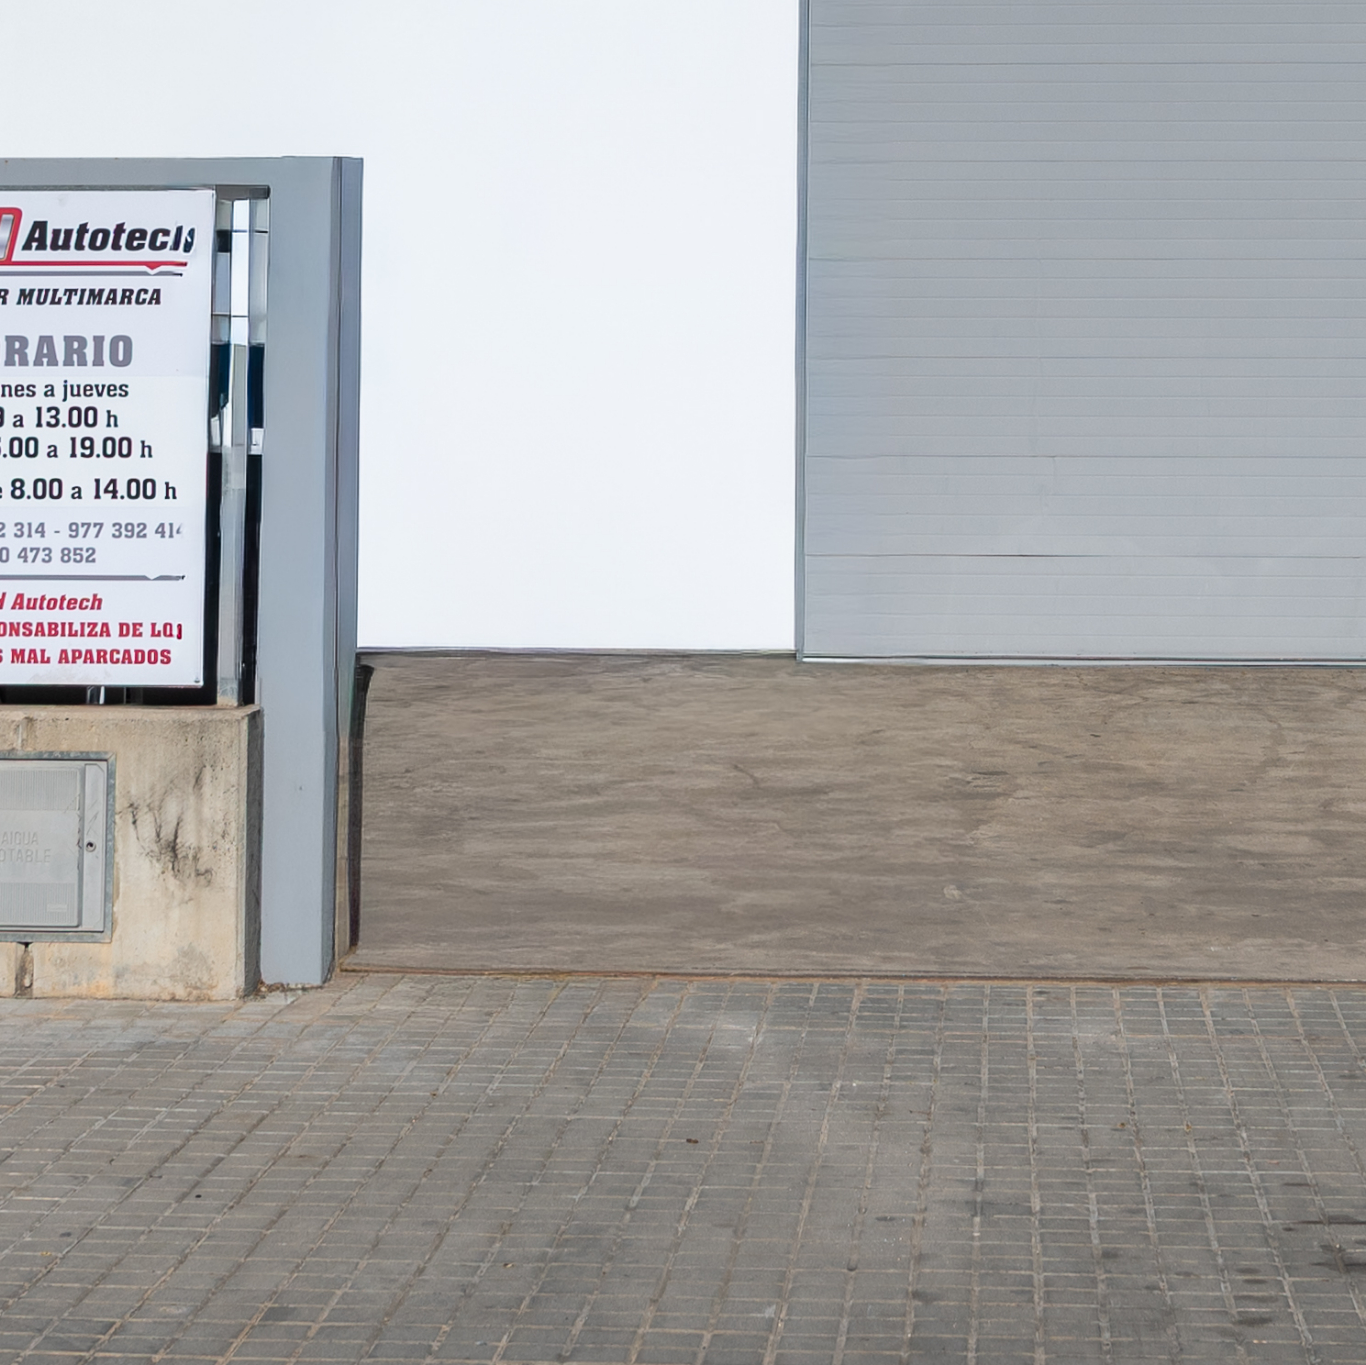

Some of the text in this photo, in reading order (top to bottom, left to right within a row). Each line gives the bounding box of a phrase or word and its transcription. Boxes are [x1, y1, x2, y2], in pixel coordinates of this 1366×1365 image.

[16, 288, 162, 305] MULTIMARCA
[43, 384, 56, 398] a
[61, 380, 129, 402] jueves
[12, 414, 24, 428] a
[36, 406, 98, 428] 13.00
[106, 409, 119, 428] h
[46, 445, 59, 459] a
[69, 437, 133, 459] 19.00
[140, 440, 153, 458] h
[10, 478, 63, 500] 8.00
[70, 486, 83, 500] a
[93, 478, 157, 500] 14.00
[164, 481, 178, 500] h
[13, 522, 46, 538] 314
[68, 522, 103, 538] 977
[111, 522, 147, 539] 392
[17, 546, 53, 564] 473
[60, 546, 96, 564] 852
[10, 593, 103, 611] Autotech
[118, 622, 143, 638] DE
[10, 648, 51, 665] MAL
[57, 648, 172, 665] APARCADOS
[1, 830, 39, 845] AIGUA
